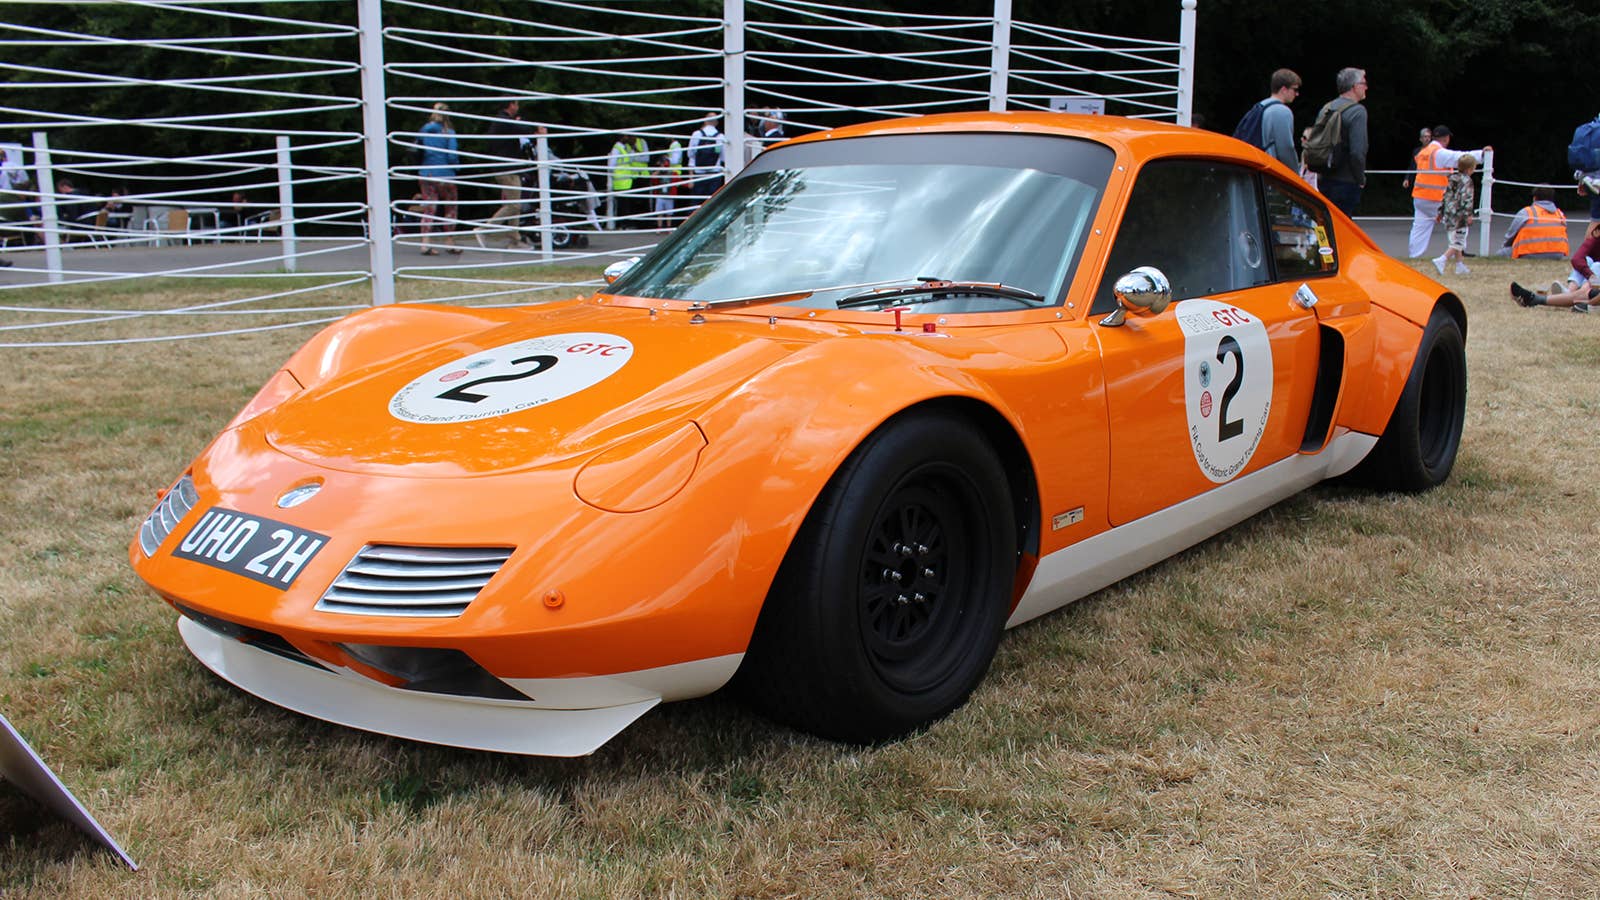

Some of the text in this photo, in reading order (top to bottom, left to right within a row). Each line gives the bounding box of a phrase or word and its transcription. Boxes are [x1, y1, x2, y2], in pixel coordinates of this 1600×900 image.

[418, 414, 455, 422] Grand
[458, 408, 511, 420] Touring
[515, 397, 549, 409] Cars
[434, 354, 559, 404] 2
[1216, 335, 1244, 442] 2
[1192, 424, 1200, 444] FIA
[1196, 442, 1204, 463] Cup
[1209, 465, 1228, 478] Historic
[1228, 456, 1245, 475] Grand
[1245, 427, 1262, 458] Touring
[1260, 401, 1270, 426] Cars
[180, 511, 323, 584] UHO 2H
